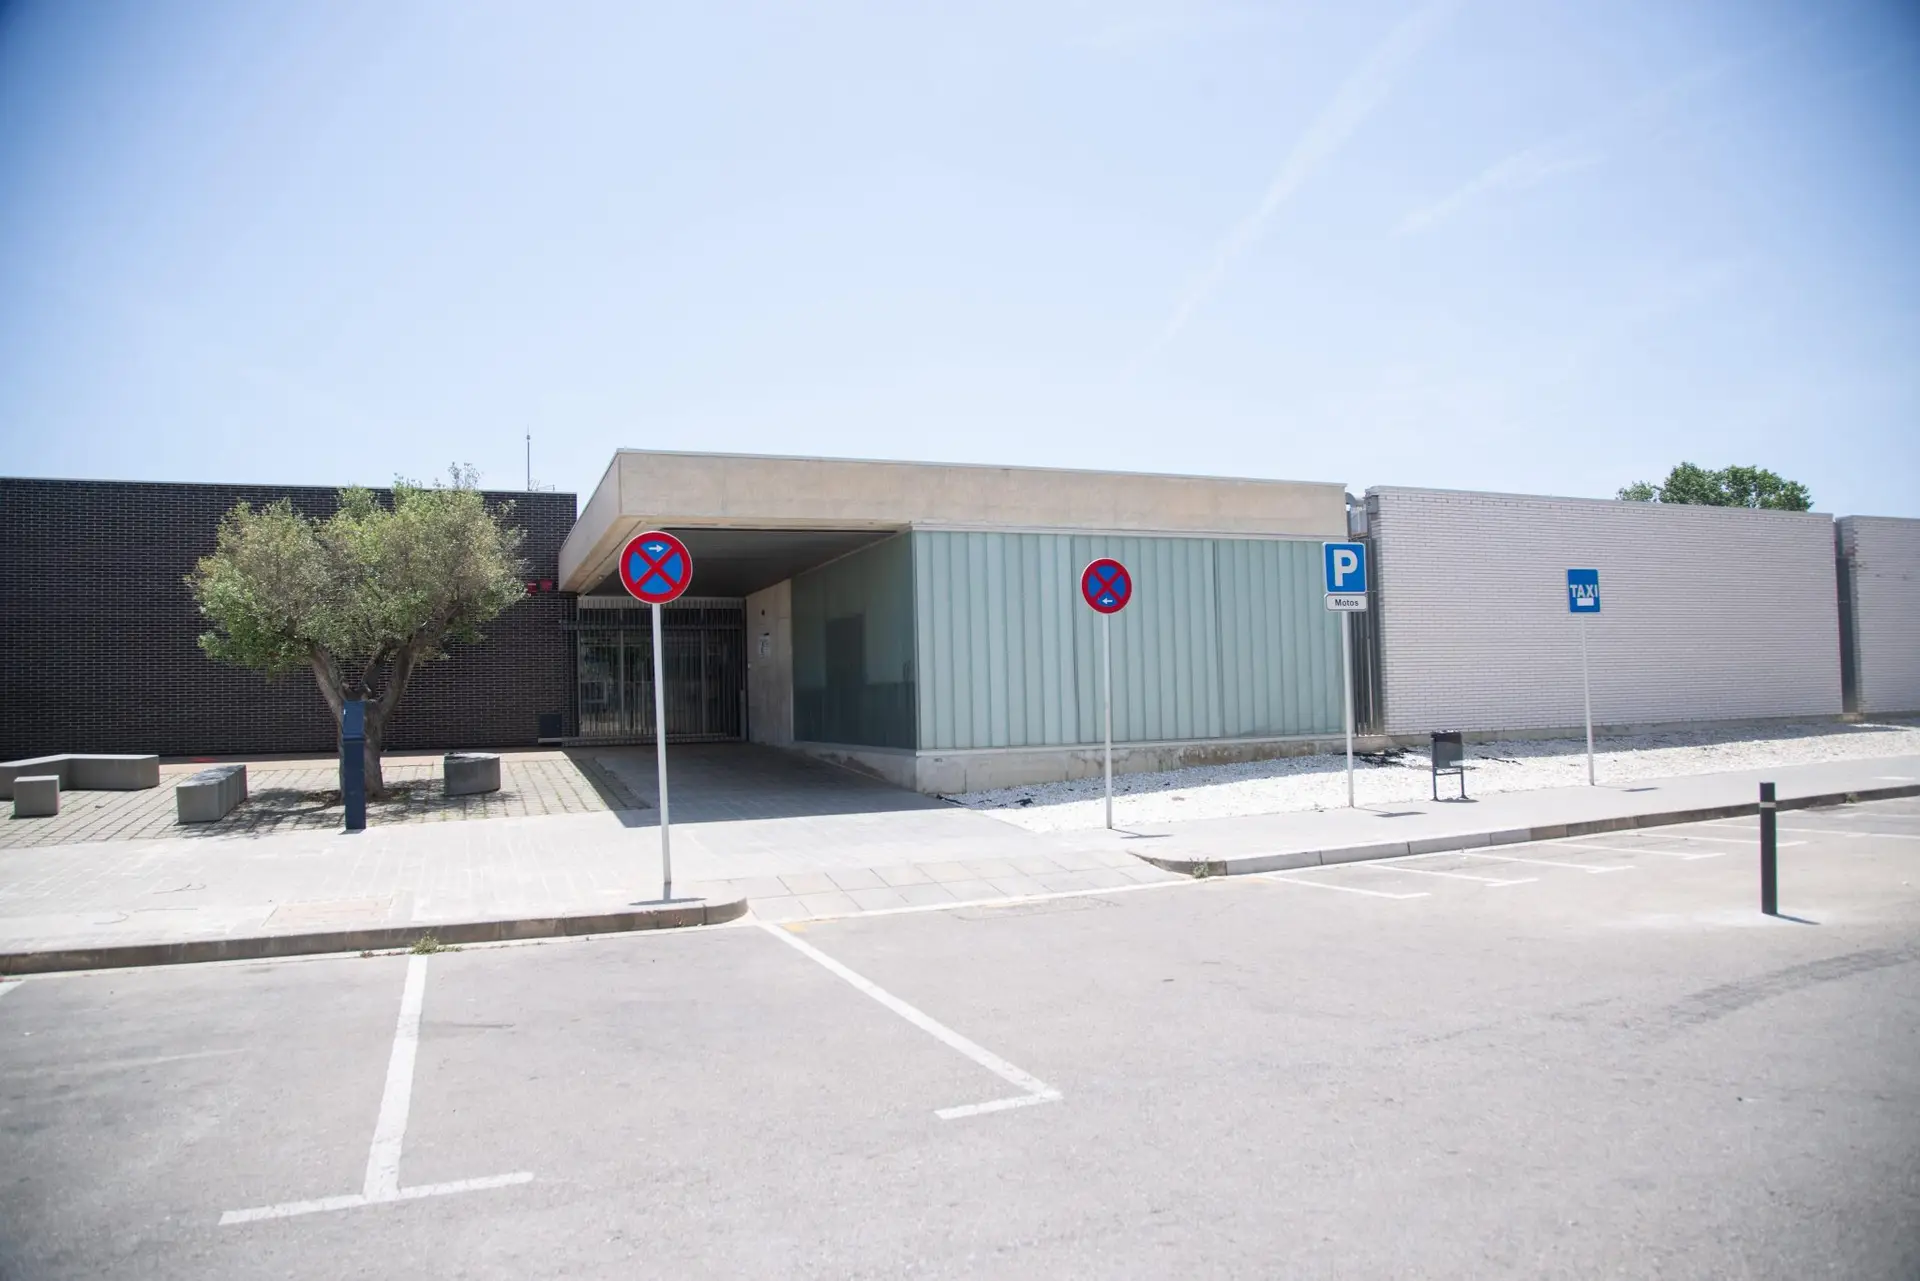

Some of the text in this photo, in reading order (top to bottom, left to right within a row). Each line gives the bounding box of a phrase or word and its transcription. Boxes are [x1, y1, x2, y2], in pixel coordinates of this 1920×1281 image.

[1333, 549, 1358, 587] P
[1569, 584, 1598, 598] TAXI
[1334, 599, 1359, 607] Motos
